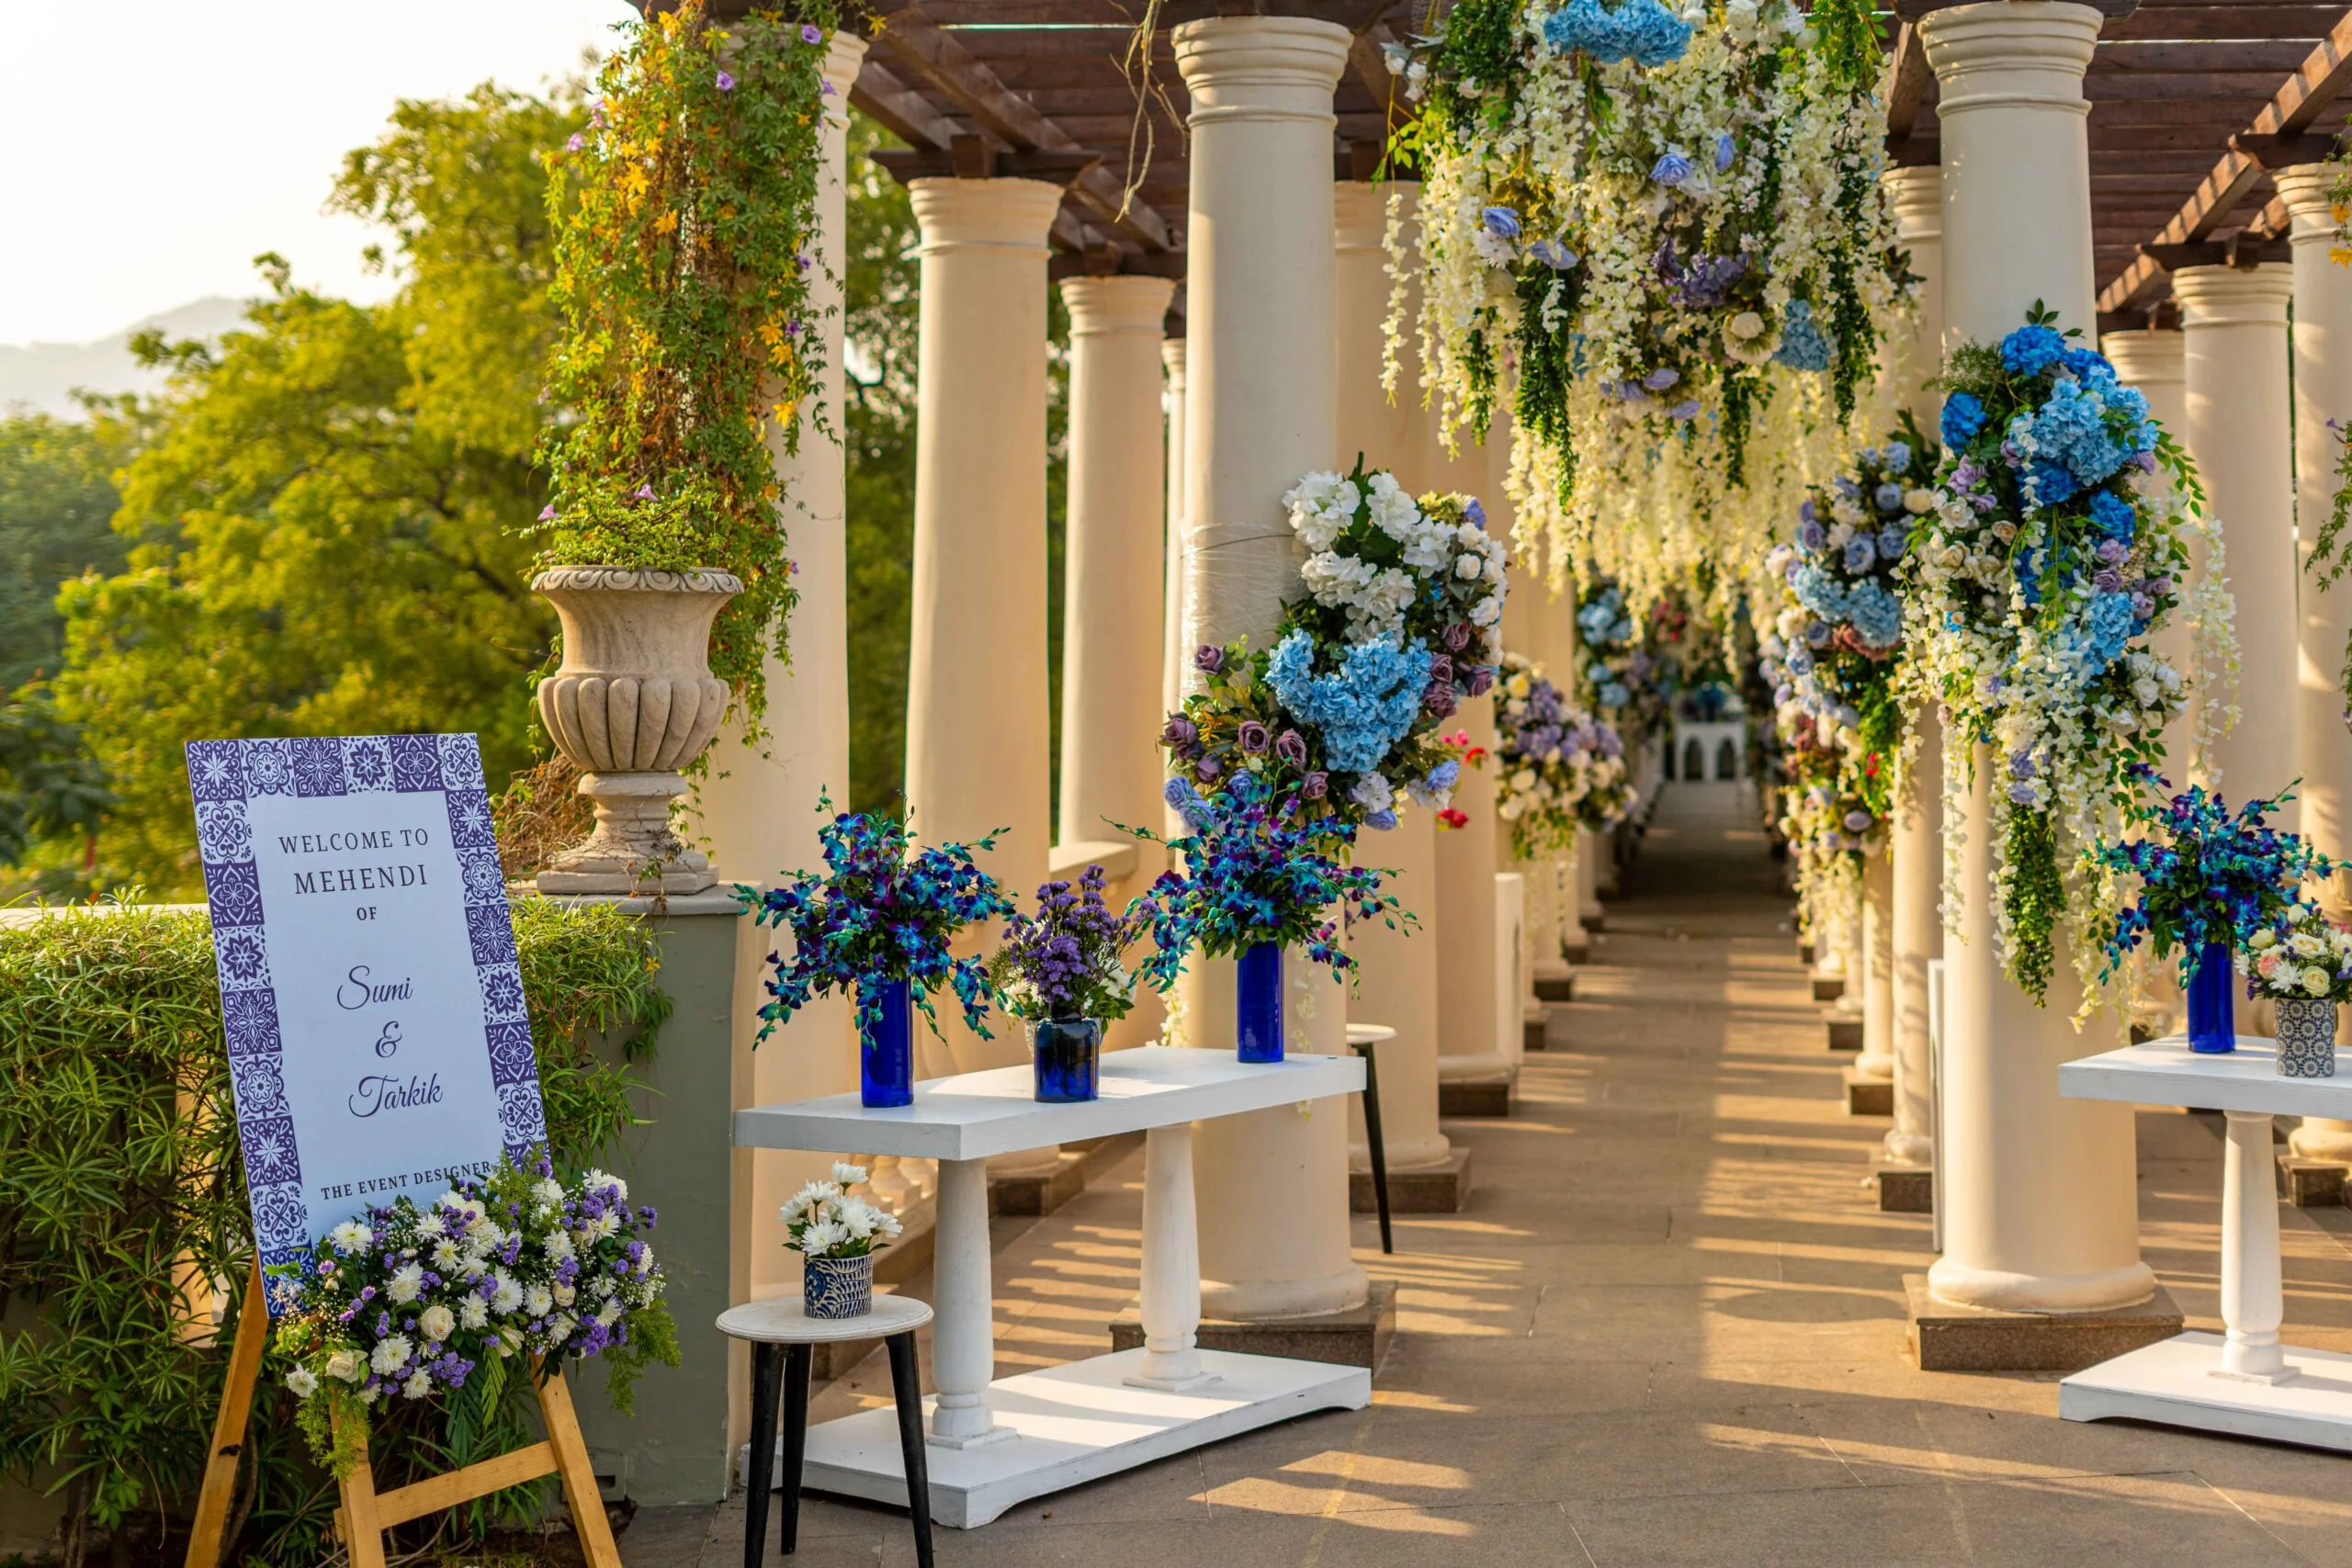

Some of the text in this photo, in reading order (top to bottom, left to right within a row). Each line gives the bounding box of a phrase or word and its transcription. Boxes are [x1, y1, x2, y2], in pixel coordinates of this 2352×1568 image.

[277, 828, 429, 854] WELCOME TO
[293, 863, 428, 895] MEHENDI
[356, 906, 378, 921] OF
[336, 964, 413, 1010] Sumi
[375, 1020, 402, 1059] &
[348, 1072, 444, 1118] Tarkik
[320, 1183, 353, 1201] THE
[357, 1174, 409, 1194] EVENT
